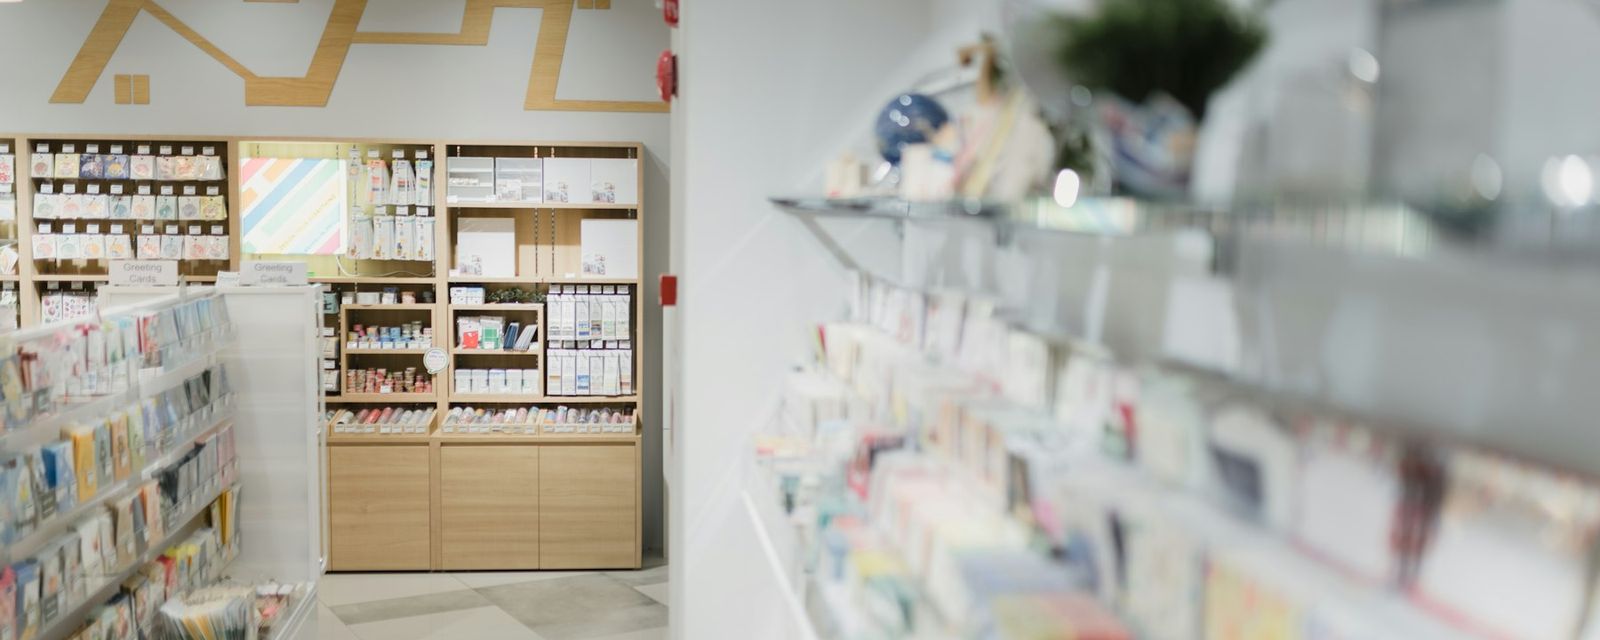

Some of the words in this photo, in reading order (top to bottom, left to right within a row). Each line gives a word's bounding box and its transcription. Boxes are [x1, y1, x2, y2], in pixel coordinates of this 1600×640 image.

[123, 263, 162, 273] Greeting
[254, 263, 293, 273] Greeting
[129, 274, 156, 283] Cards
[260, 274, 287, 283] Cards
